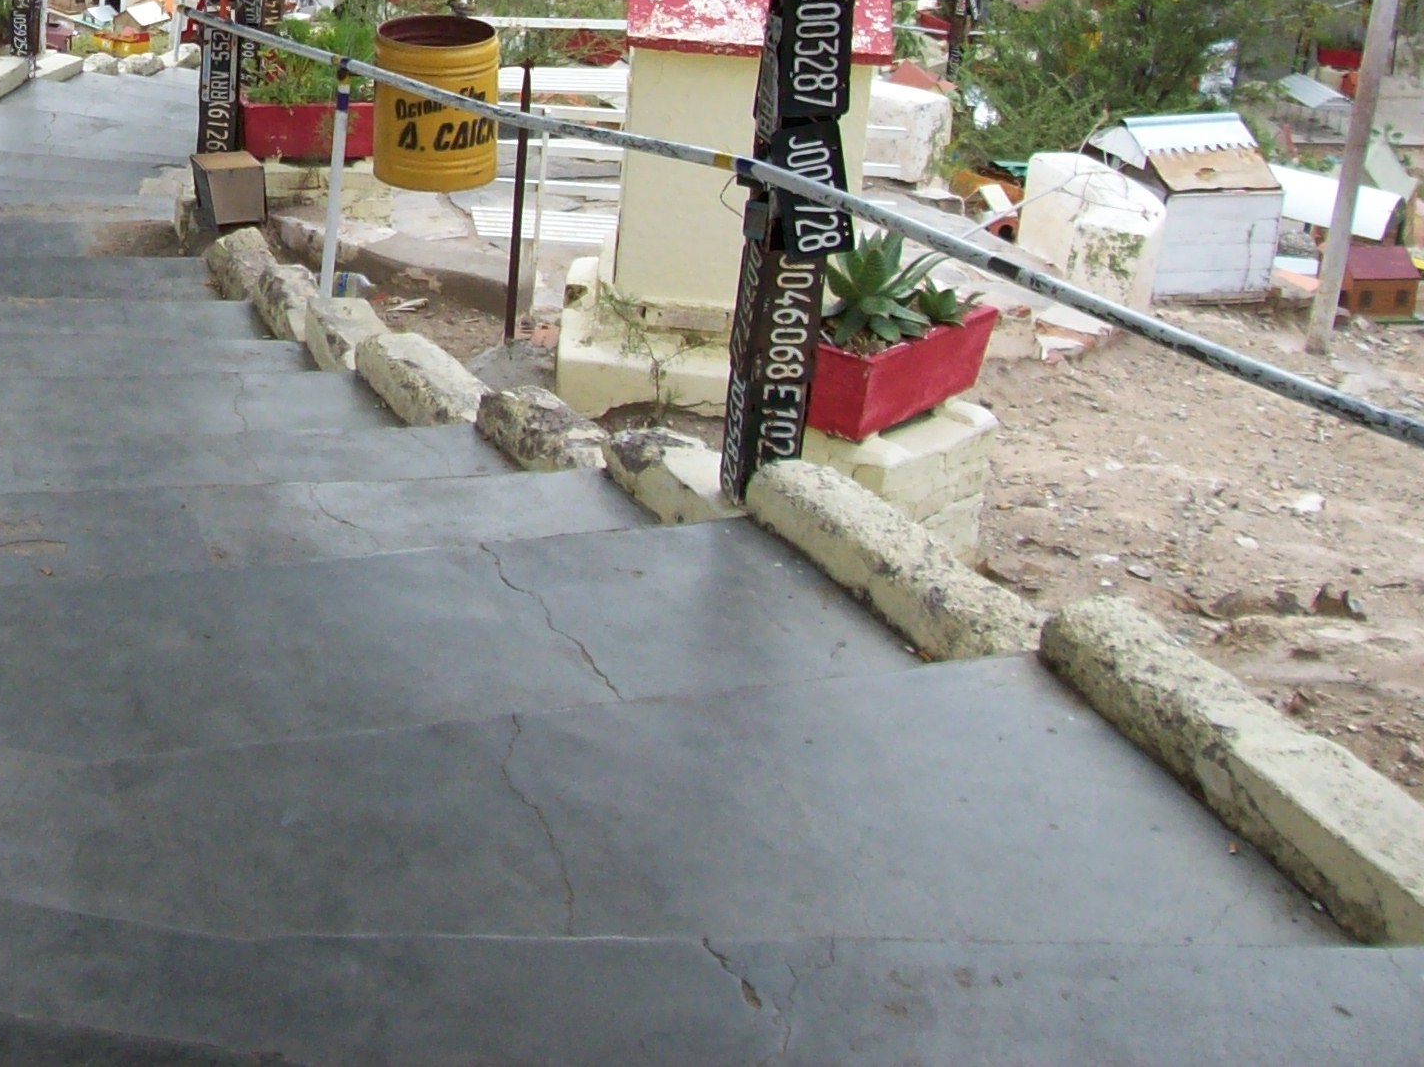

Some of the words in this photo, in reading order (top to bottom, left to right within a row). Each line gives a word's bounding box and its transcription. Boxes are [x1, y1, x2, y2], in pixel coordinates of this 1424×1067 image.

[211, 31, 231, 62] 552
[210, 70, 230, 100] RRV
[785, 135, 843, 253] J00728
[765, 255, 817, 380] J046068
